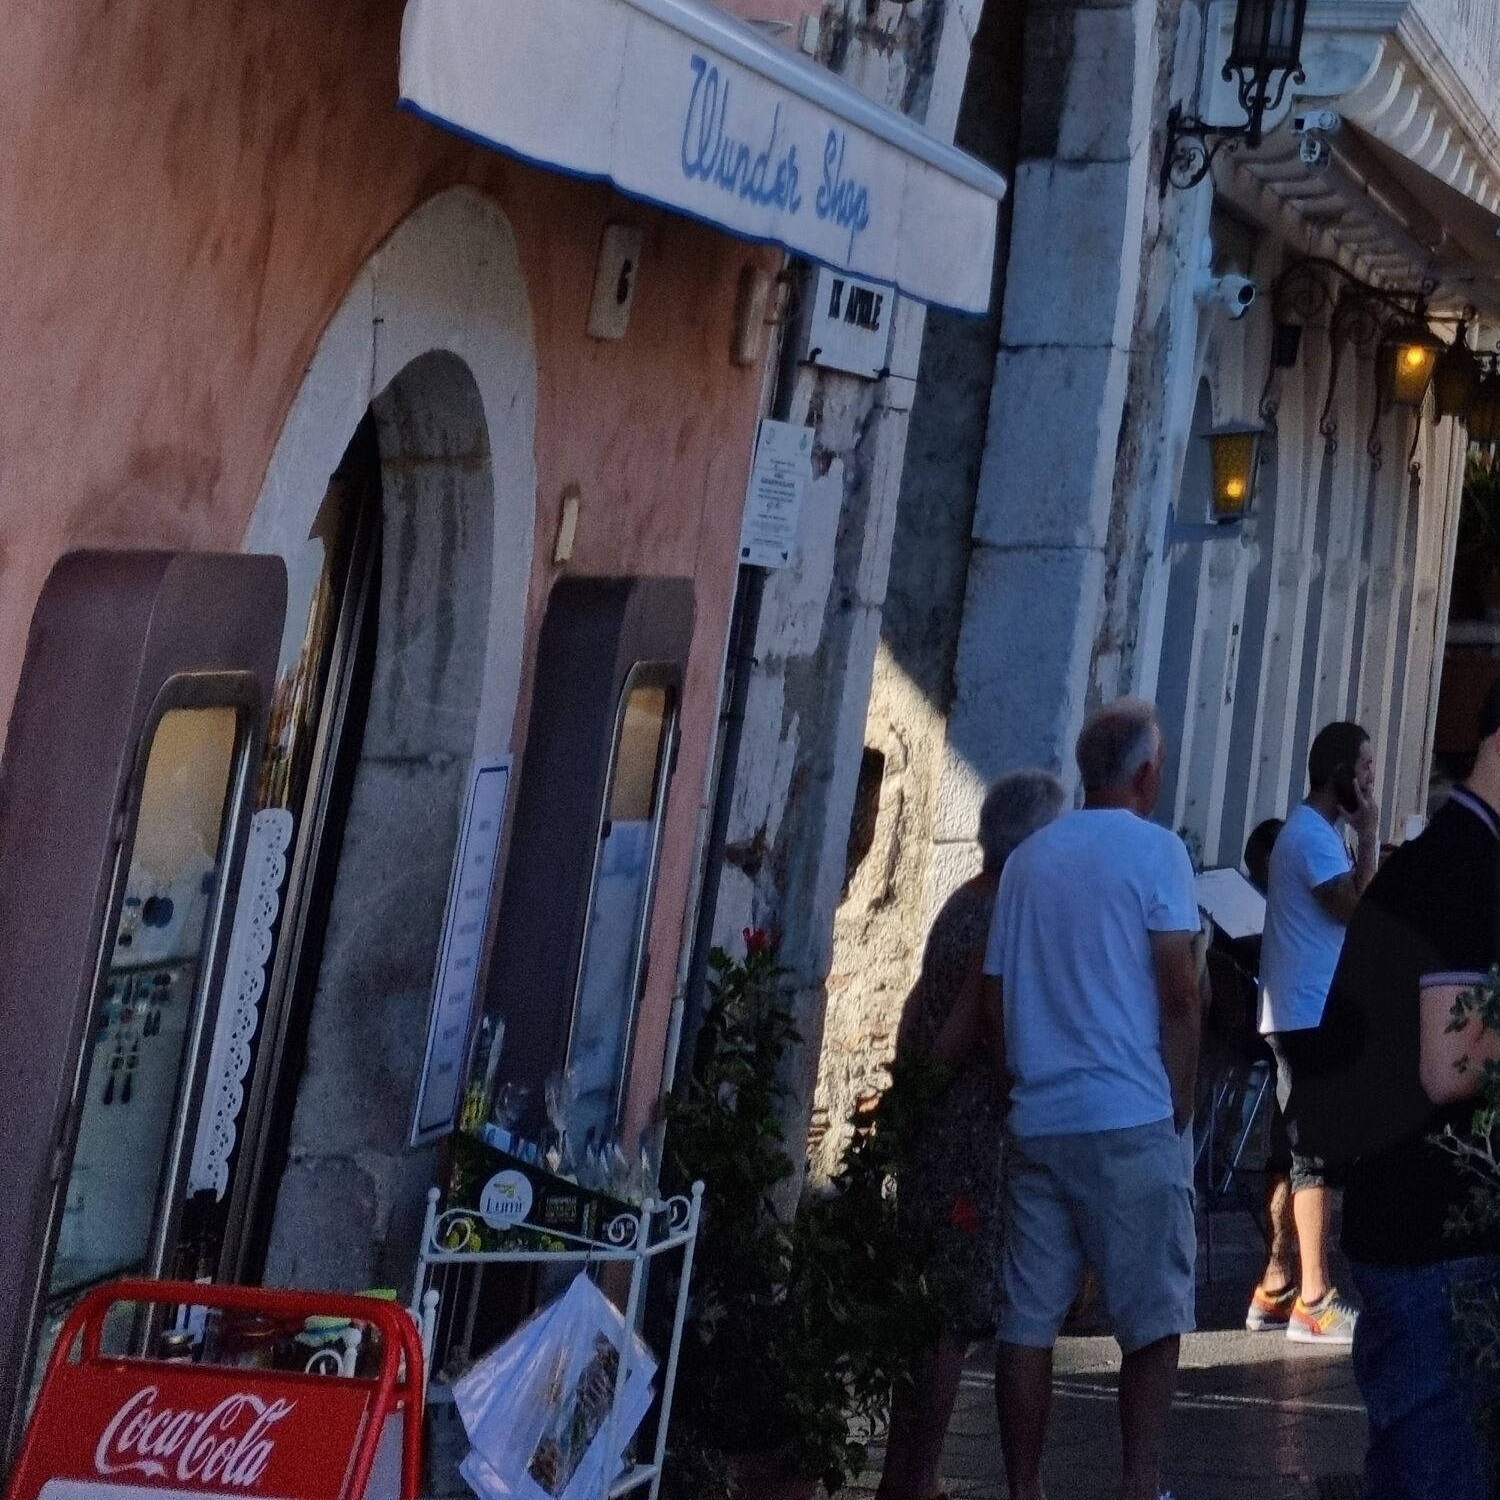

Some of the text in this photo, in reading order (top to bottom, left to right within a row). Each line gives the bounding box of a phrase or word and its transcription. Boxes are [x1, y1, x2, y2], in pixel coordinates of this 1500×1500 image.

[681, 54, 869, 264] Wunder Shop
[94, 1385, 298, 1488] Coca-Cola
